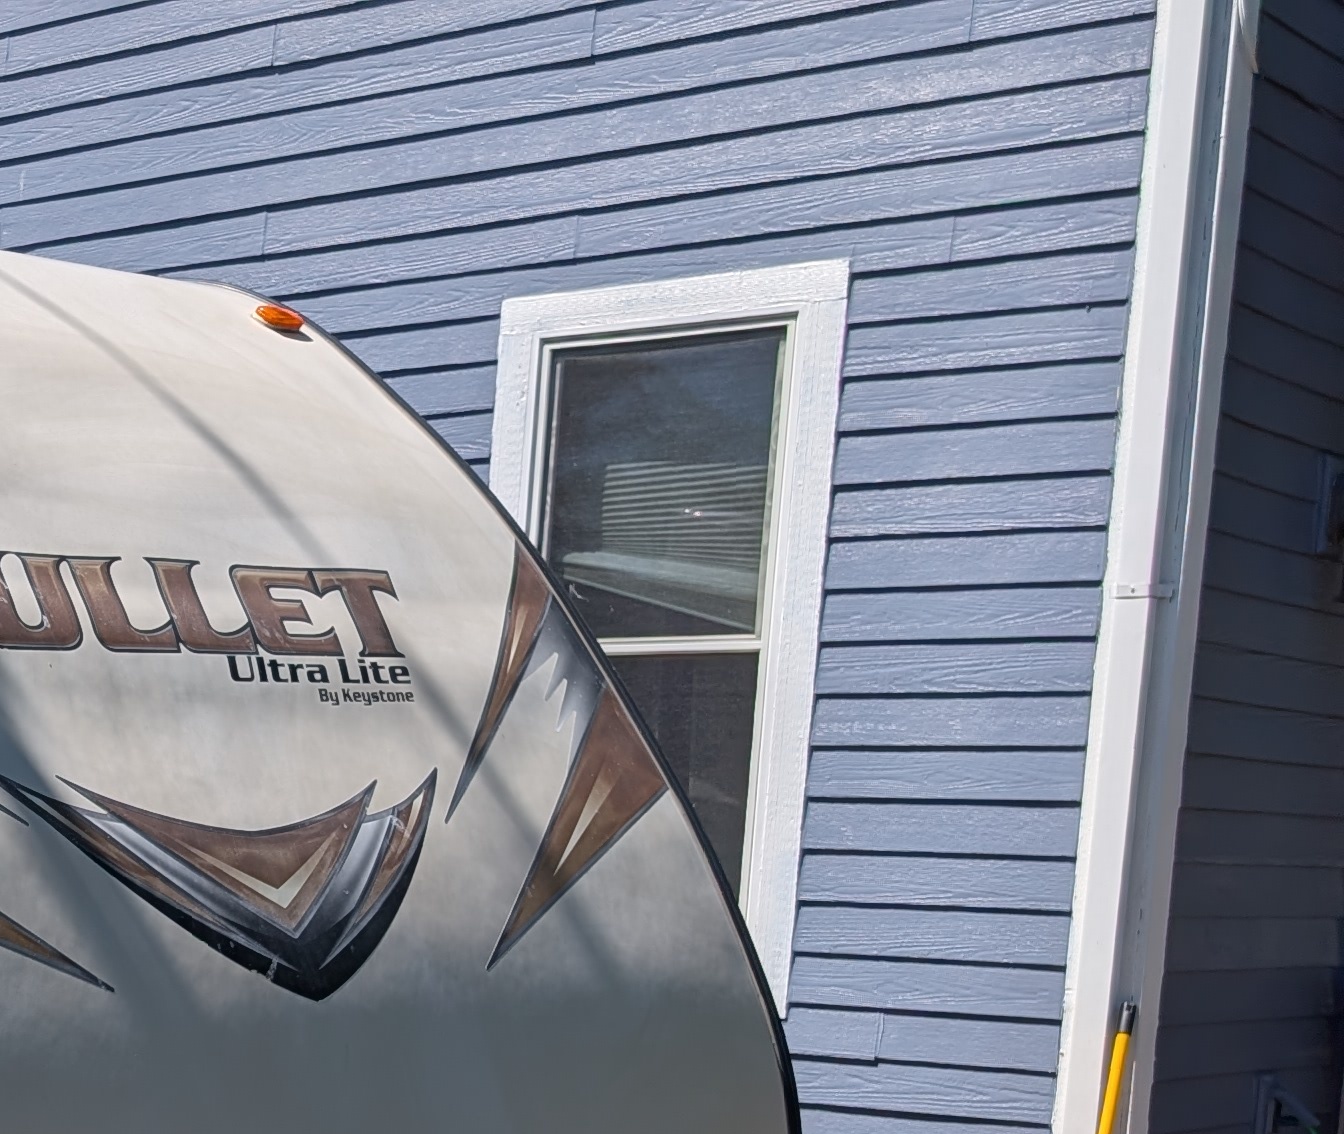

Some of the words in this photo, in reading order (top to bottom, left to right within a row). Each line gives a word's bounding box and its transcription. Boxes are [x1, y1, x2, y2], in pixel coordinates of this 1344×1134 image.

[227, 655, 330, 684] Ultra
[337, 658, 412, 684] Lite
[318, 688, 340, 706] By
[342, 688, 415, 706] Keystone
